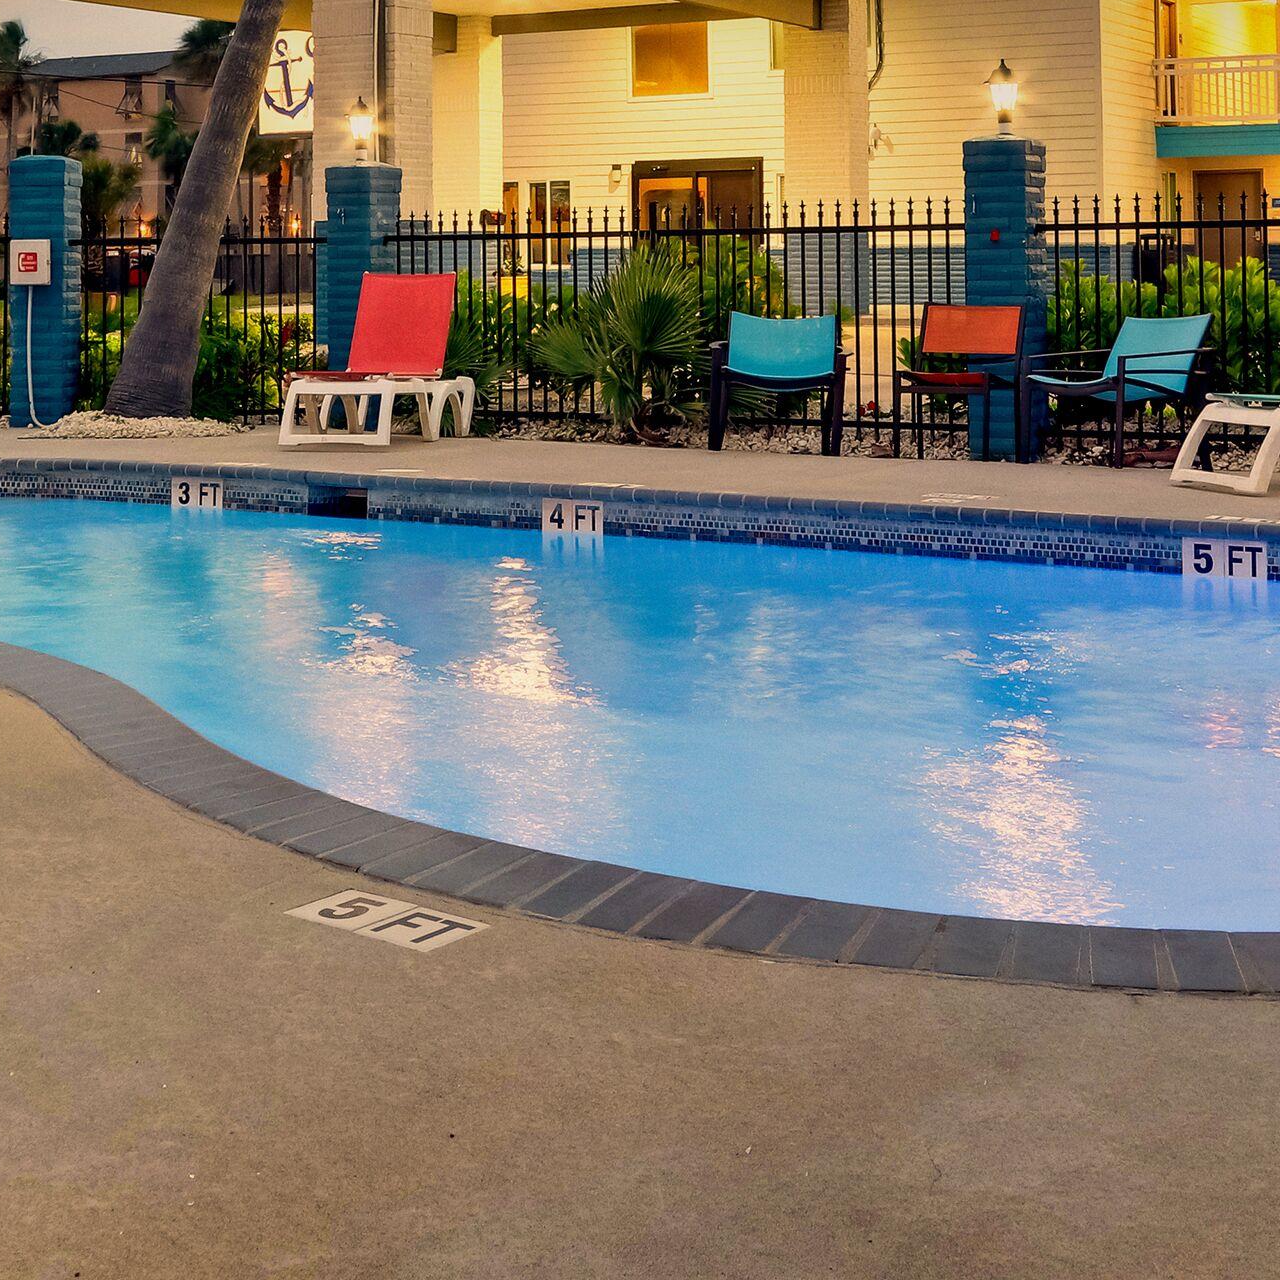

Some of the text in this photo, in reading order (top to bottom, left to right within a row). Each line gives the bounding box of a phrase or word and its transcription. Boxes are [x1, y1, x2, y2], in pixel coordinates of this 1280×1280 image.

[178, 481, 221, 507] 3 FT
[549, 503, 601, 532] 4 FT
[1193, 543, 1264, 578] 5 FT
[318, 896, 477, 944] 5 FT
